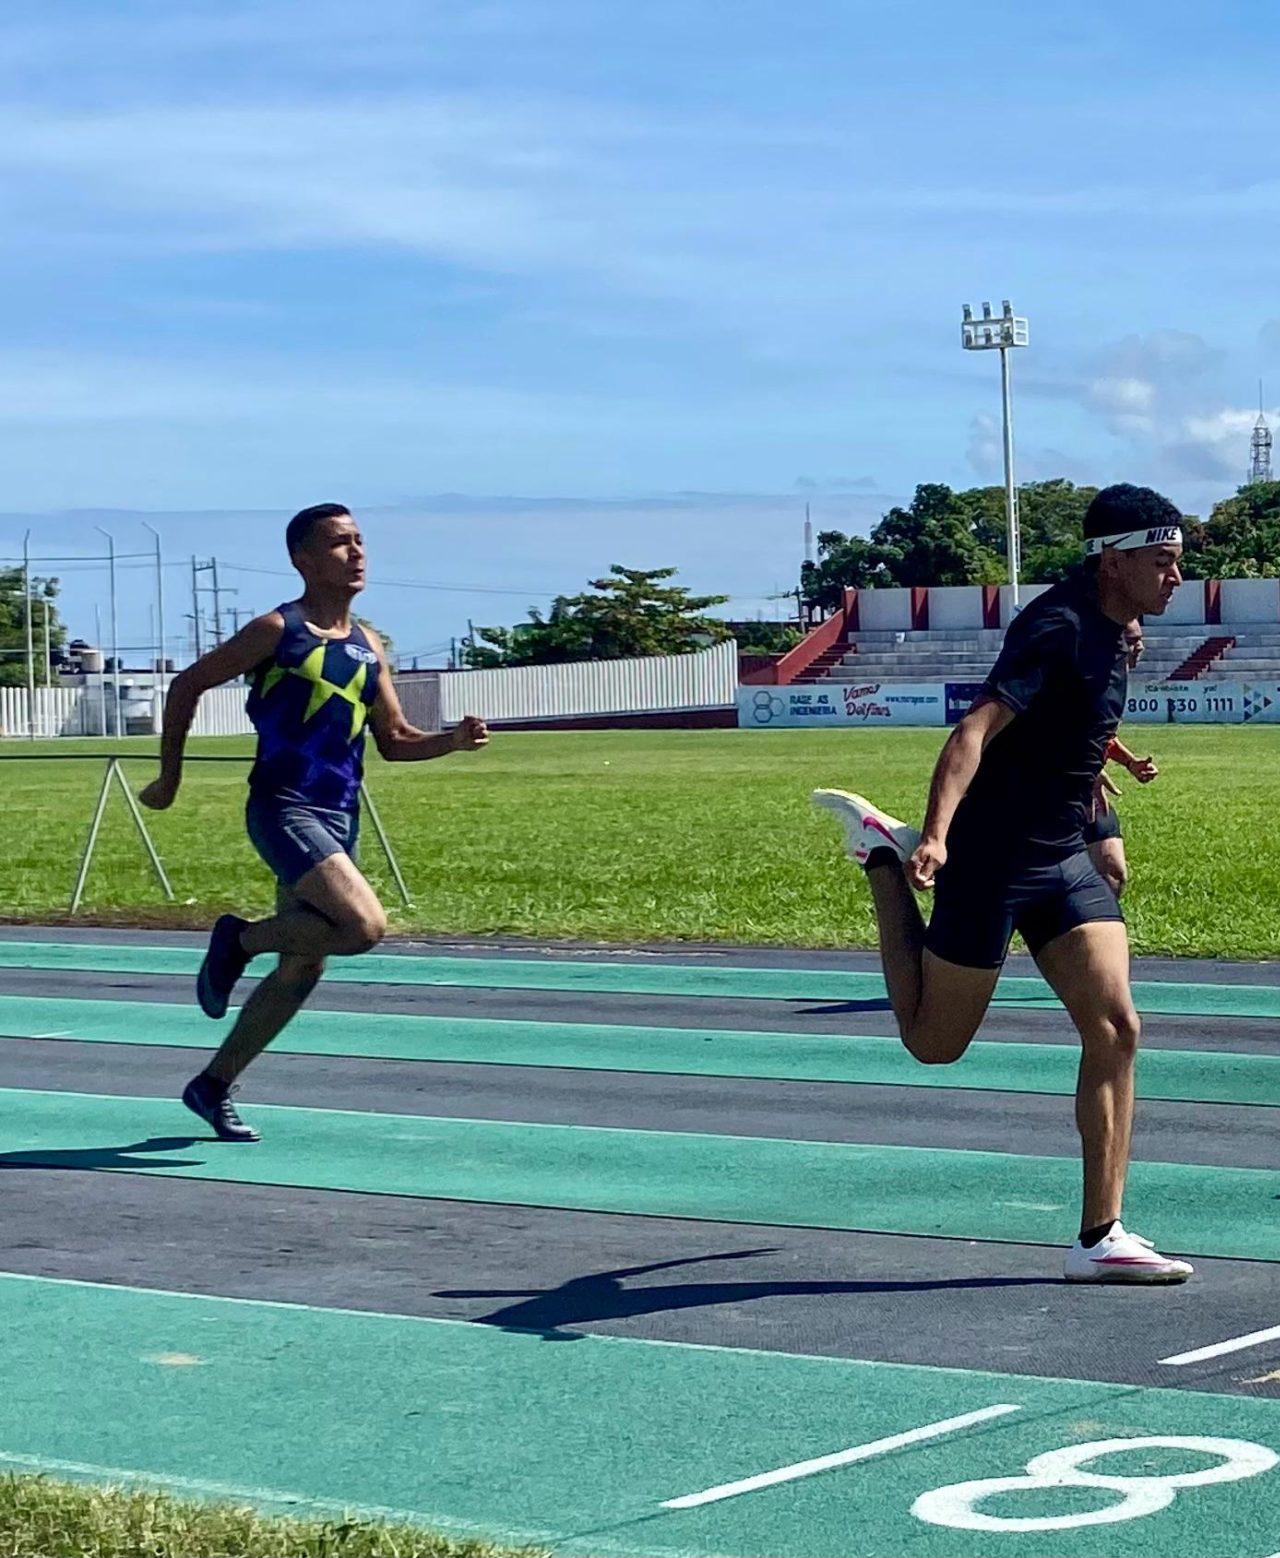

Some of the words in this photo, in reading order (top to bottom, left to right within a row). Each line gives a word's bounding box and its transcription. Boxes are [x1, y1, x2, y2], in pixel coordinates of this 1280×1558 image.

[1146, 527, 1178, 543] NIKE
[843, 684, 880, 702] Vamos
[1127, 698, 1159, 712] 800
[1206, 698, 1233, 711] 1111
